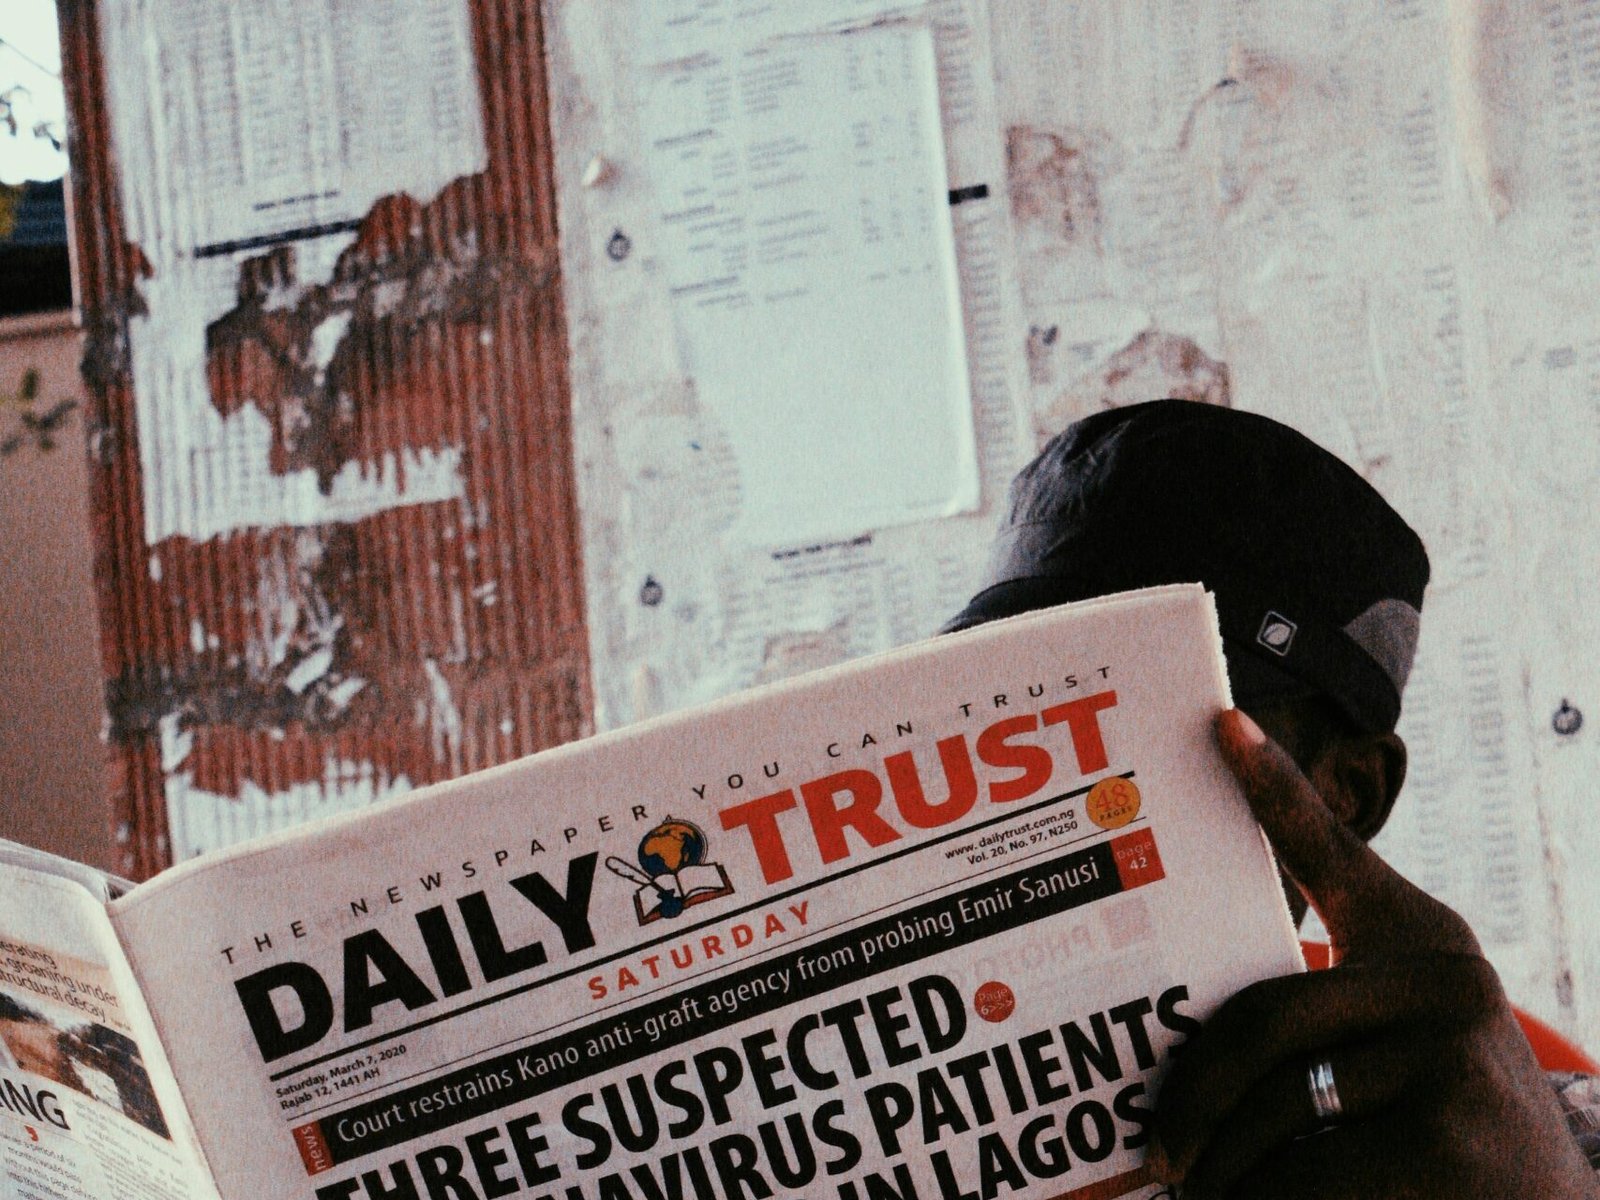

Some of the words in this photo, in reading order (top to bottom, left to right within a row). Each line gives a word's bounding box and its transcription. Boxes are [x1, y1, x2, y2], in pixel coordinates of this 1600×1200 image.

[220, 921, 306, 965] THE
[350, 805, 648, 917] NEWSPAPER
[692, 762, 780, 801] YOU
[826, 721, 913, 758] CAN
[960, 666, 1110, 718] TRUST
[1095, 783, 1127, 810] 48
[1099, 805, 1133, 822] PAGES
[967, 850, 989, 866] Vol.
[991, 846, 1008, 859] 20,
[1009, 838, 1029, 851] No.
[1030, 831, 1047, 845] 97,
[1048, 820, 1078, 838] N250
[1115, 840, 1152, 860] page
[1129, 857, 1148, 870] 42
[234, 851, 599, 1063] DAILY
[718, 690, 1118, 886] TRUST
[588, 901, 810, 1000] SATURDAY
[7, 957, 75, 993] groaning
[78, 981, 119, 1008] under
[64, 991, 106, 1023] decay
[338, 1104, 405, 1141] Court
[409, 1070, 513, 1118] restrains
[517, 1045, 579, 1082] Kano
[586, 995, 703, 1057] anti-graft
[708, 968, 793, 1016] agency
[797, 945, 855, 981] from
[860, 912, 955, 964] probing
[958, 887, 1013, 924] Emir
[1018, 856, 1100, 903] Sanusi
[276, 1075, 328, 1098] Saturday,
[329, 1060, 365, 1078] March
[366, 1056, 377, 1065] 7,
[378, 1044, 407, 1060] 2020
[280, 1092, 313, 1110] Rajab
[315, 1086, 332, 1096] 12,
[333, 1076, 360, 1090] 1441
[363, 1067, 381, 1081] AH
[561, 974, 967, 1170] SUSPECTED
[865, 985, 1202, 1160] PATIENTS
[0, 1078, 71, 1130] ING
